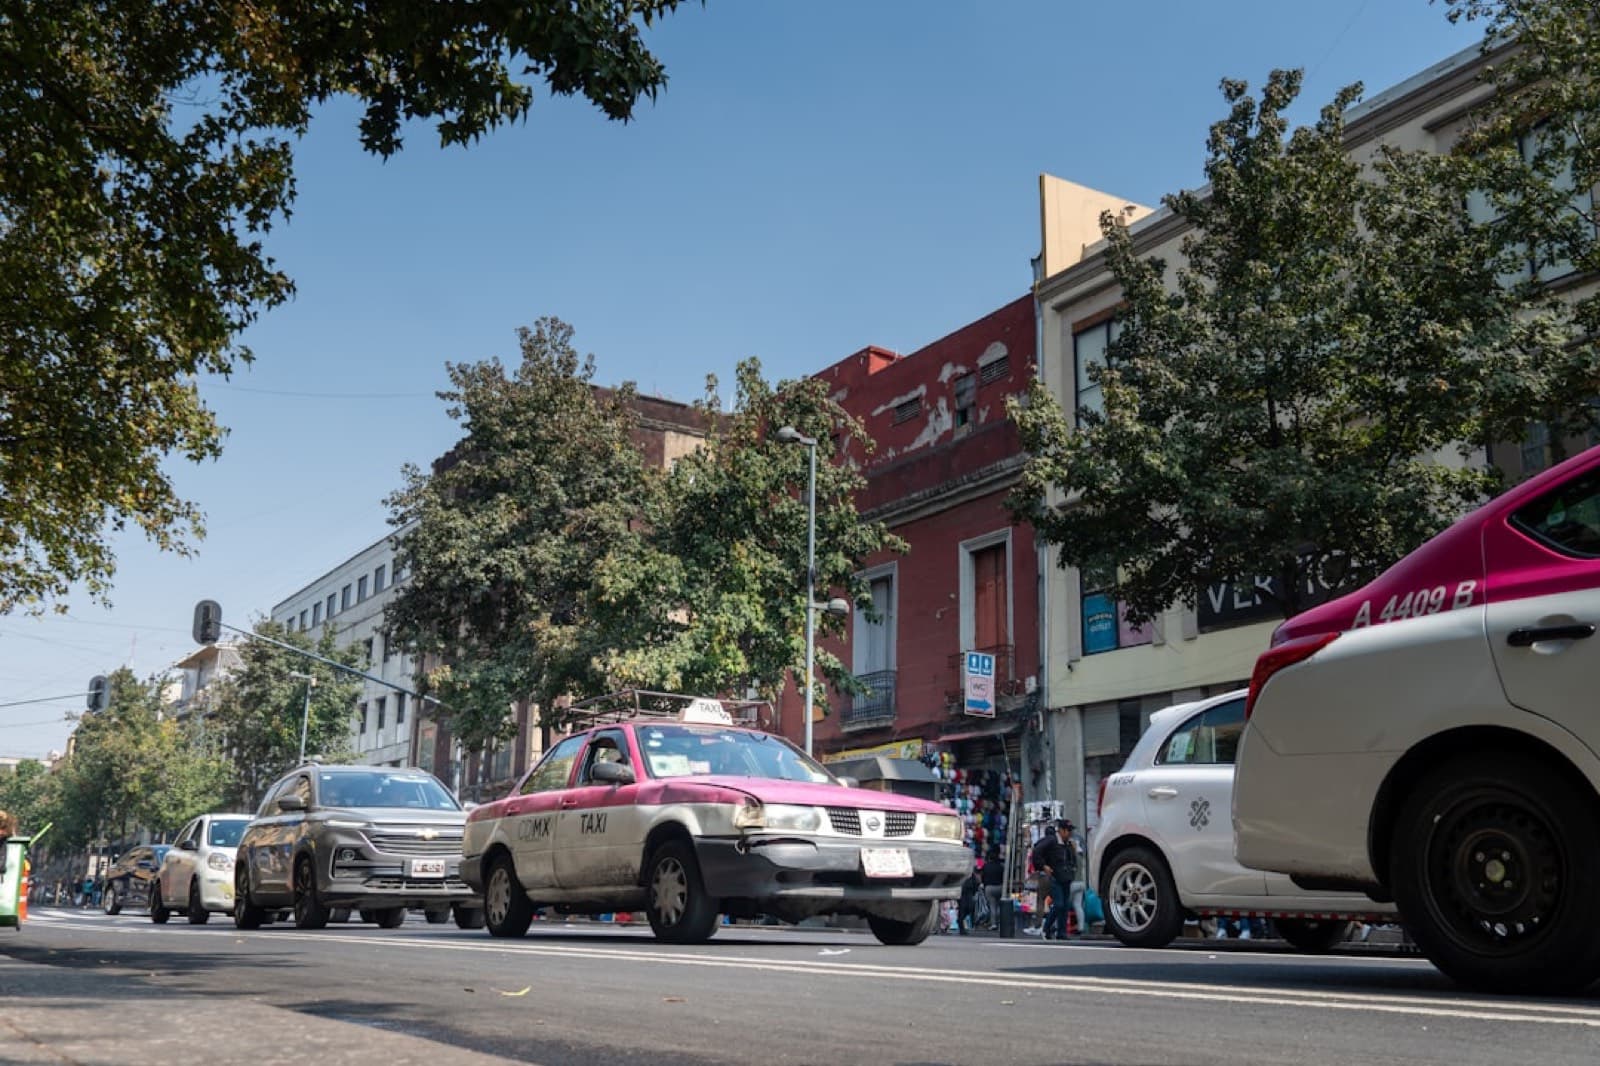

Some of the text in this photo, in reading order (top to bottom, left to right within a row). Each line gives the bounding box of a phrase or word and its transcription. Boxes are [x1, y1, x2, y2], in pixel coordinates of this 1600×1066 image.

[1352, 580, 1477, 629] A 4409 B
[699, 702, 721, 713] TAXI
[580, 812, 608, 834] TAXI
